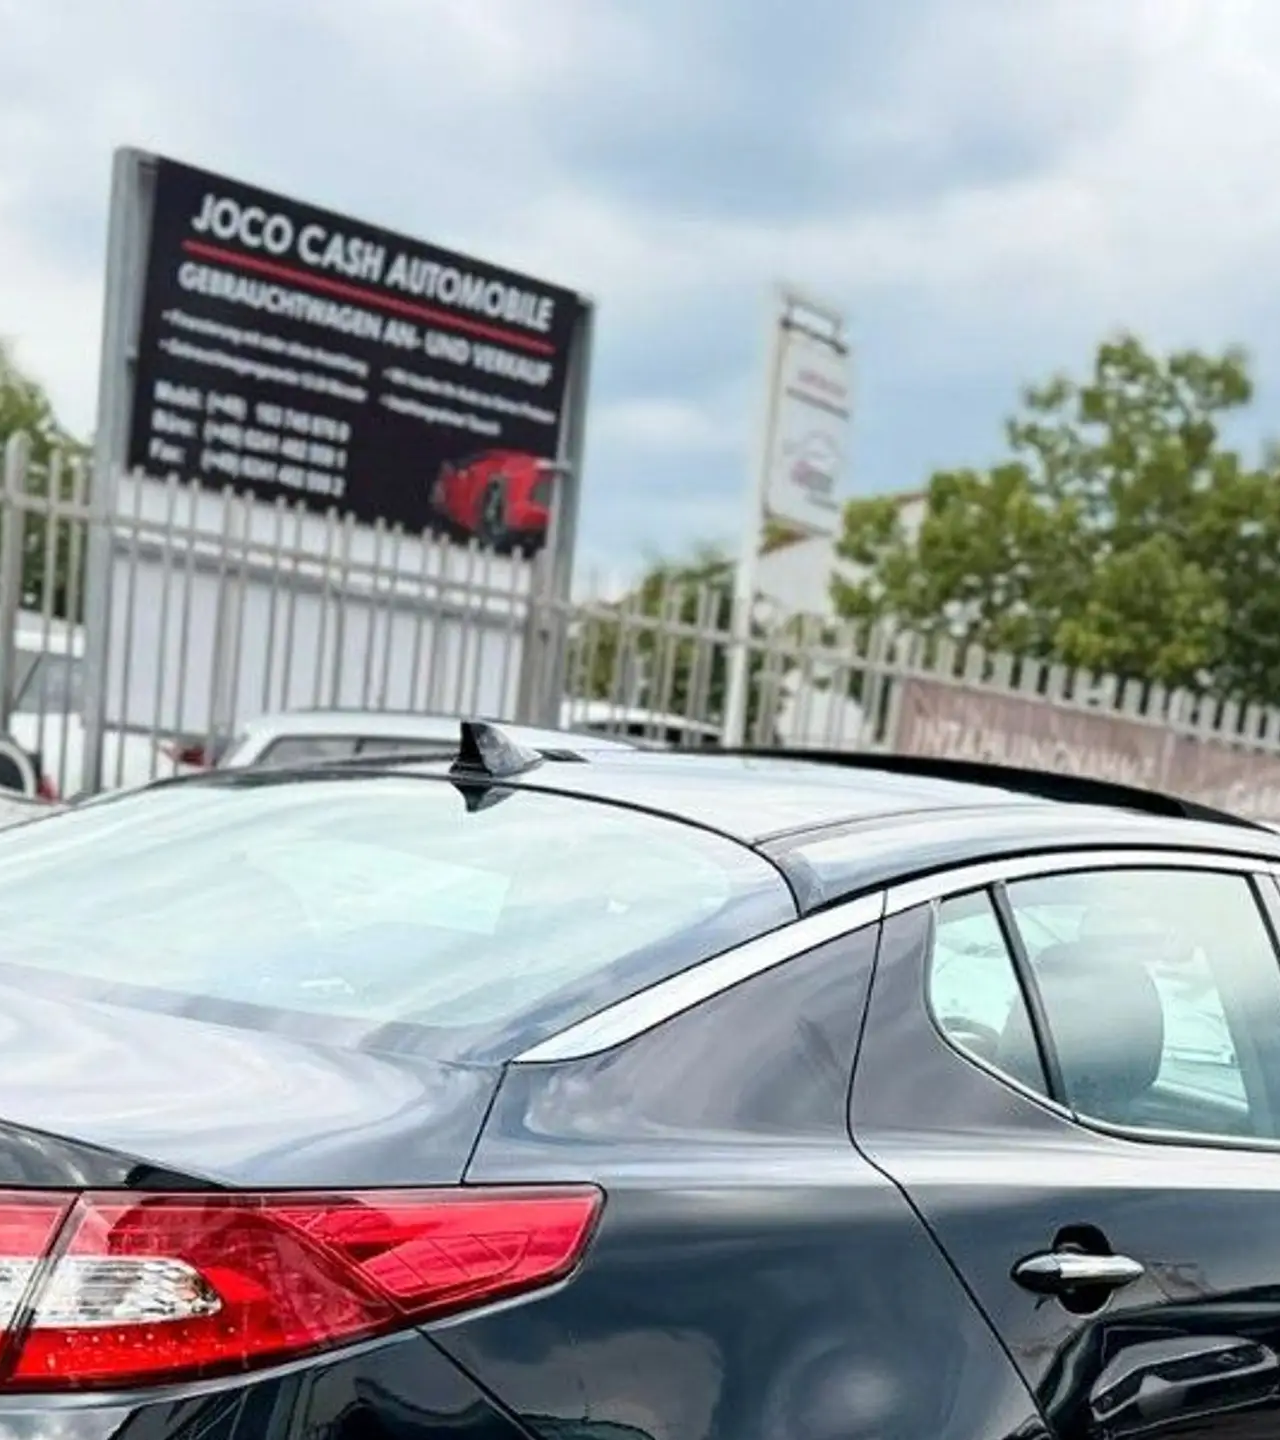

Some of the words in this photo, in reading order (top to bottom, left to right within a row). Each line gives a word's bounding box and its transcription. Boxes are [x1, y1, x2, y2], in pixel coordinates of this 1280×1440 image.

[177, 260, 384, 342] GEBRAUCHTWAGEN
[424, 329, 470, 367] UND
[471, 343, 554, 389] VERKAUF
[191, 193, 294, 254] JOCO
[297, 224, 386, 284] CASH
[384, 252, 556, 333] AUTOMOBILE
